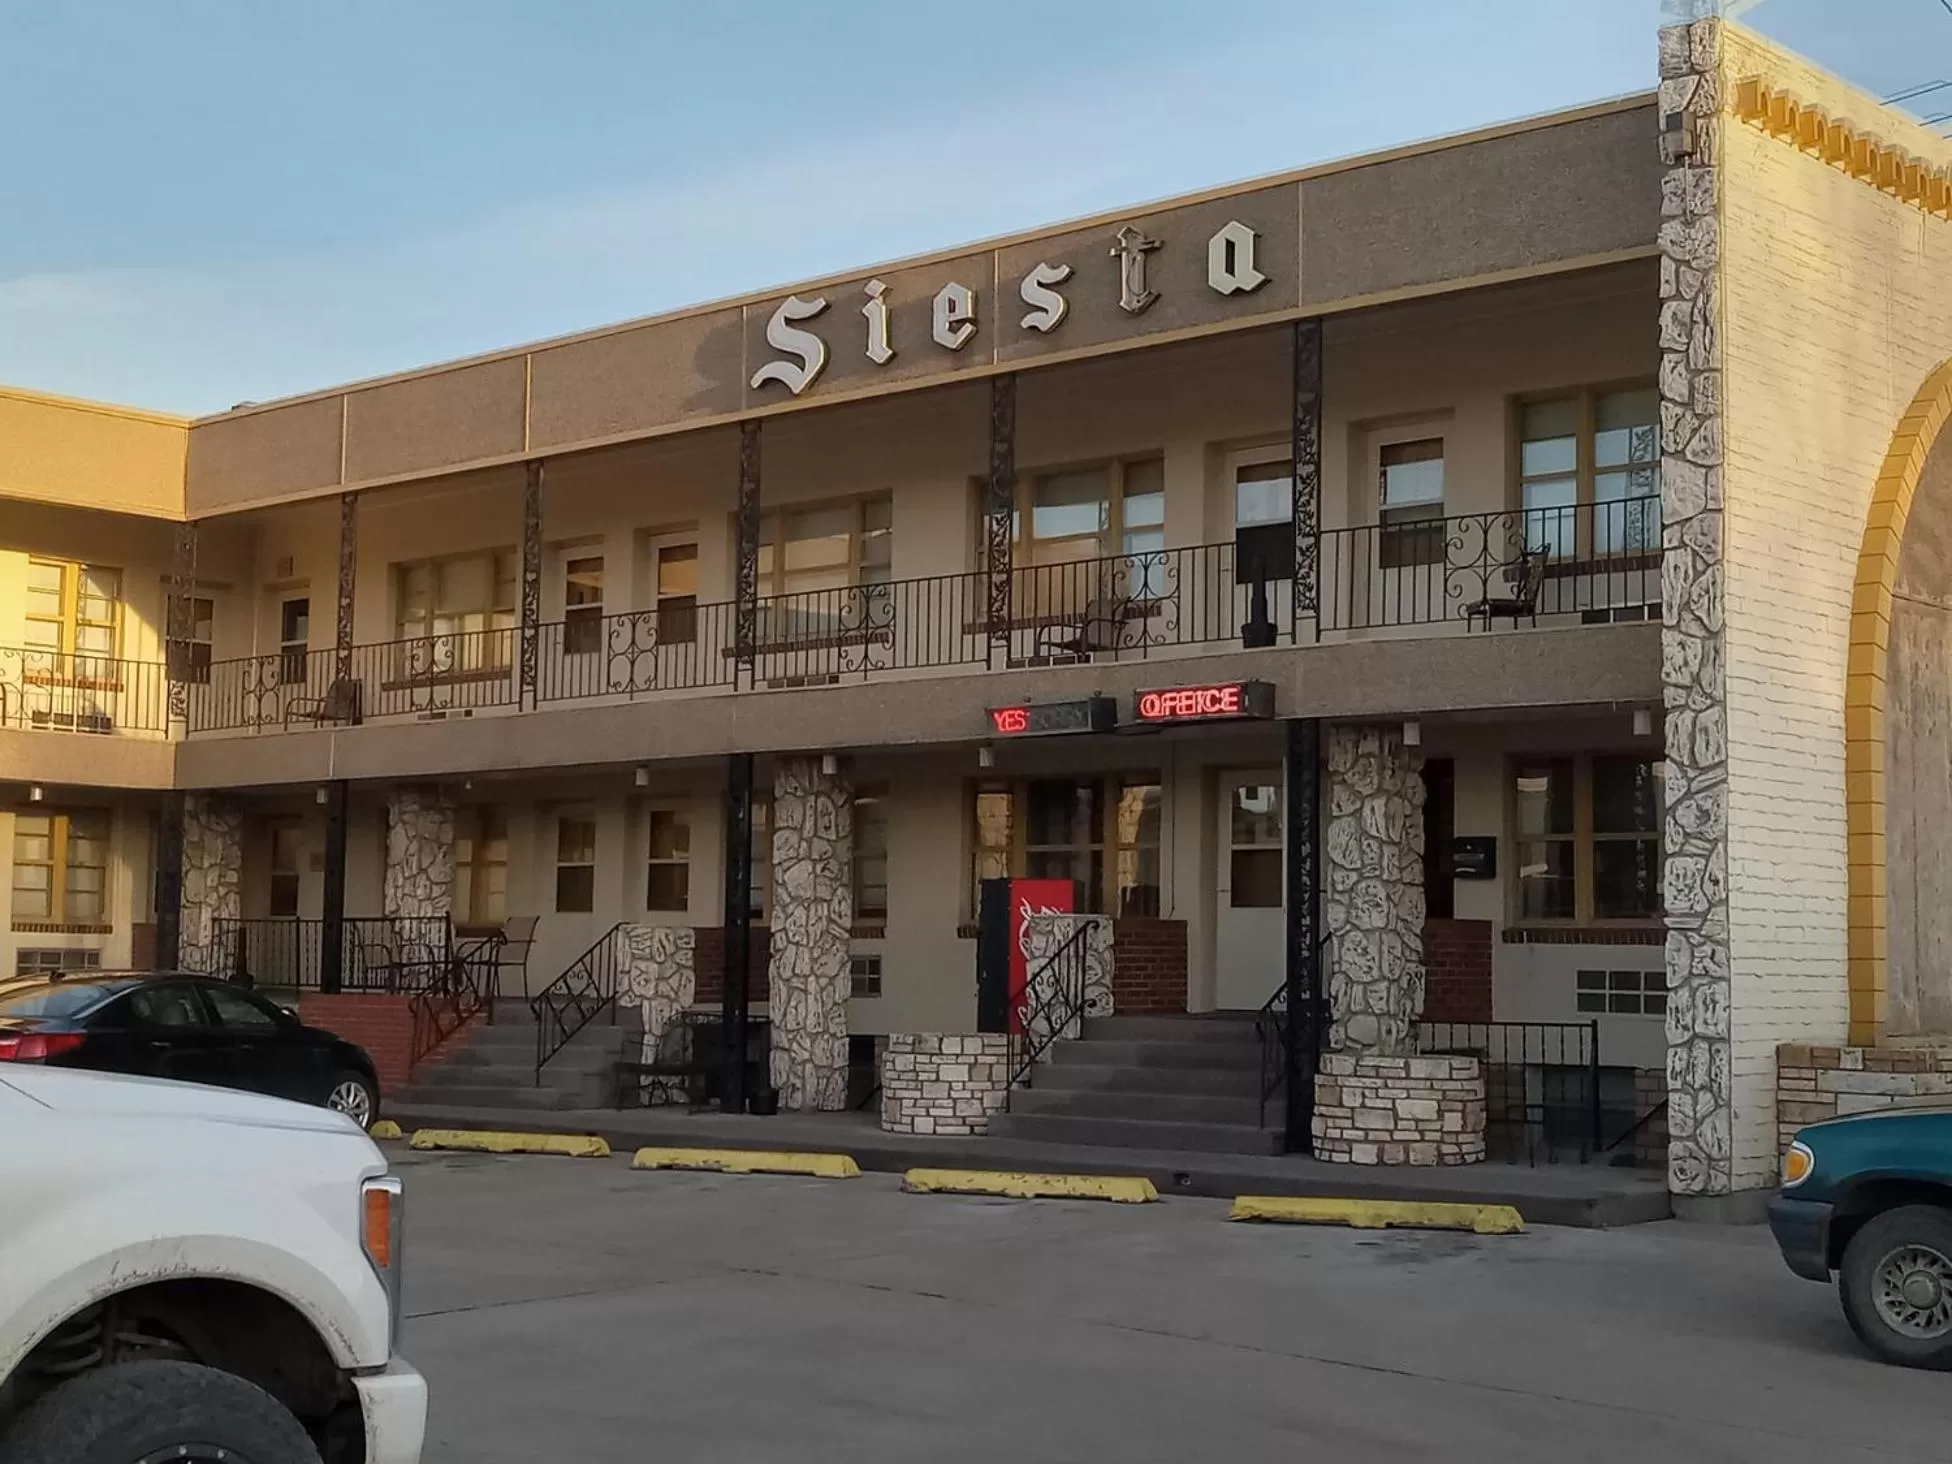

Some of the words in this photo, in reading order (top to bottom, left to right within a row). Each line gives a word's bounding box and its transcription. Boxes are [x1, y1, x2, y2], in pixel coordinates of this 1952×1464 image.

[750, 220, 1272, 394] Siesta
[1140, 687, 1239, 717] OFFICE
[993, 709, 1026, 732] YES
